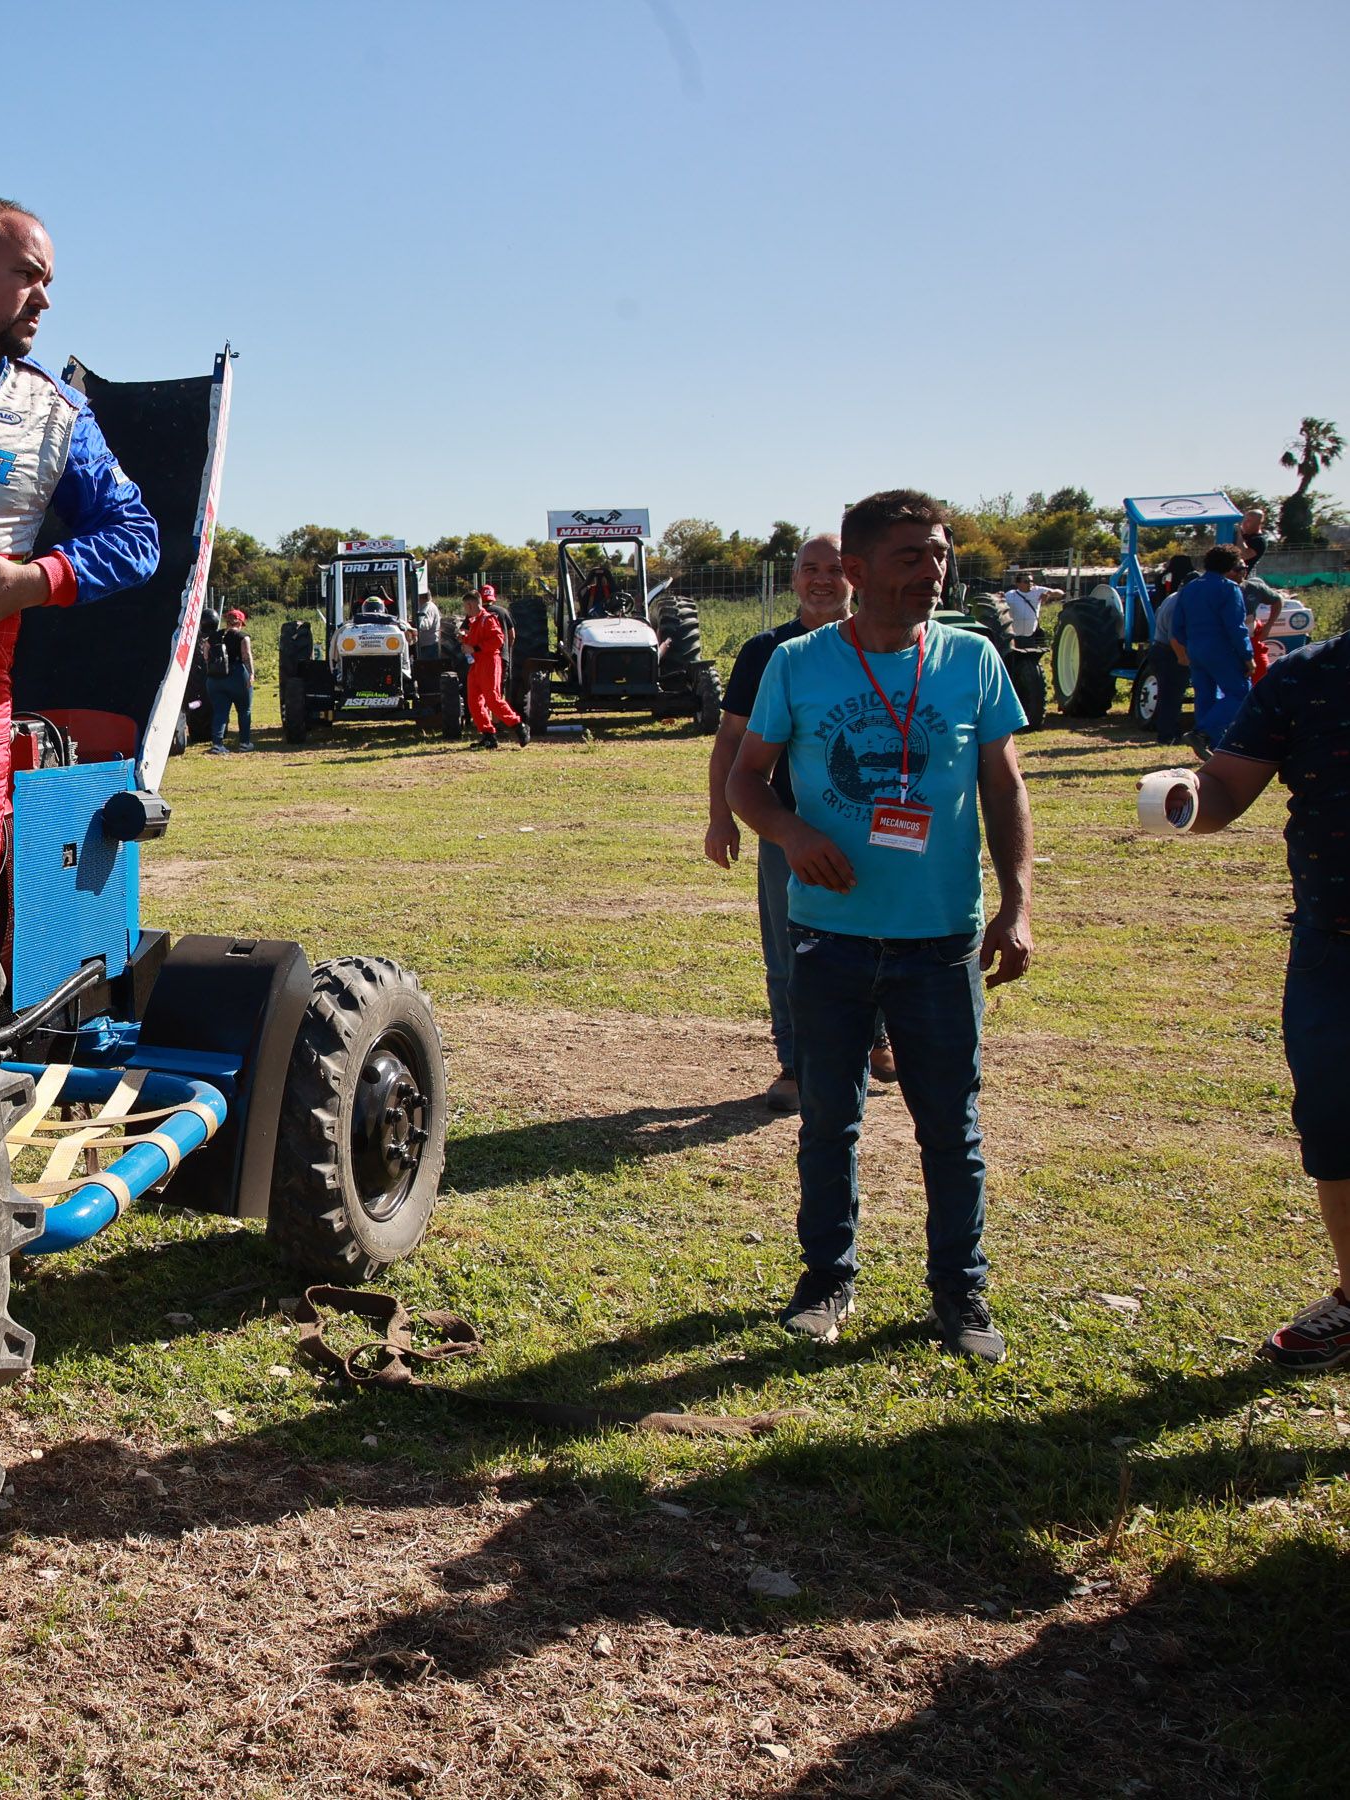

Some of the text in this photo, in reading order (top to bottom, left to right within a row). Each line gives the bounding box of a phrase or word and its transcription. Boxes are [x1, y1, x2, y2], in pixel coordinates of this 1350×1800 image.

[559, 526, 639, 536] MAFERAUTO
[890, 690, 948, 735] CMP
[879, 817, 921, 831] MECÁNICOS
